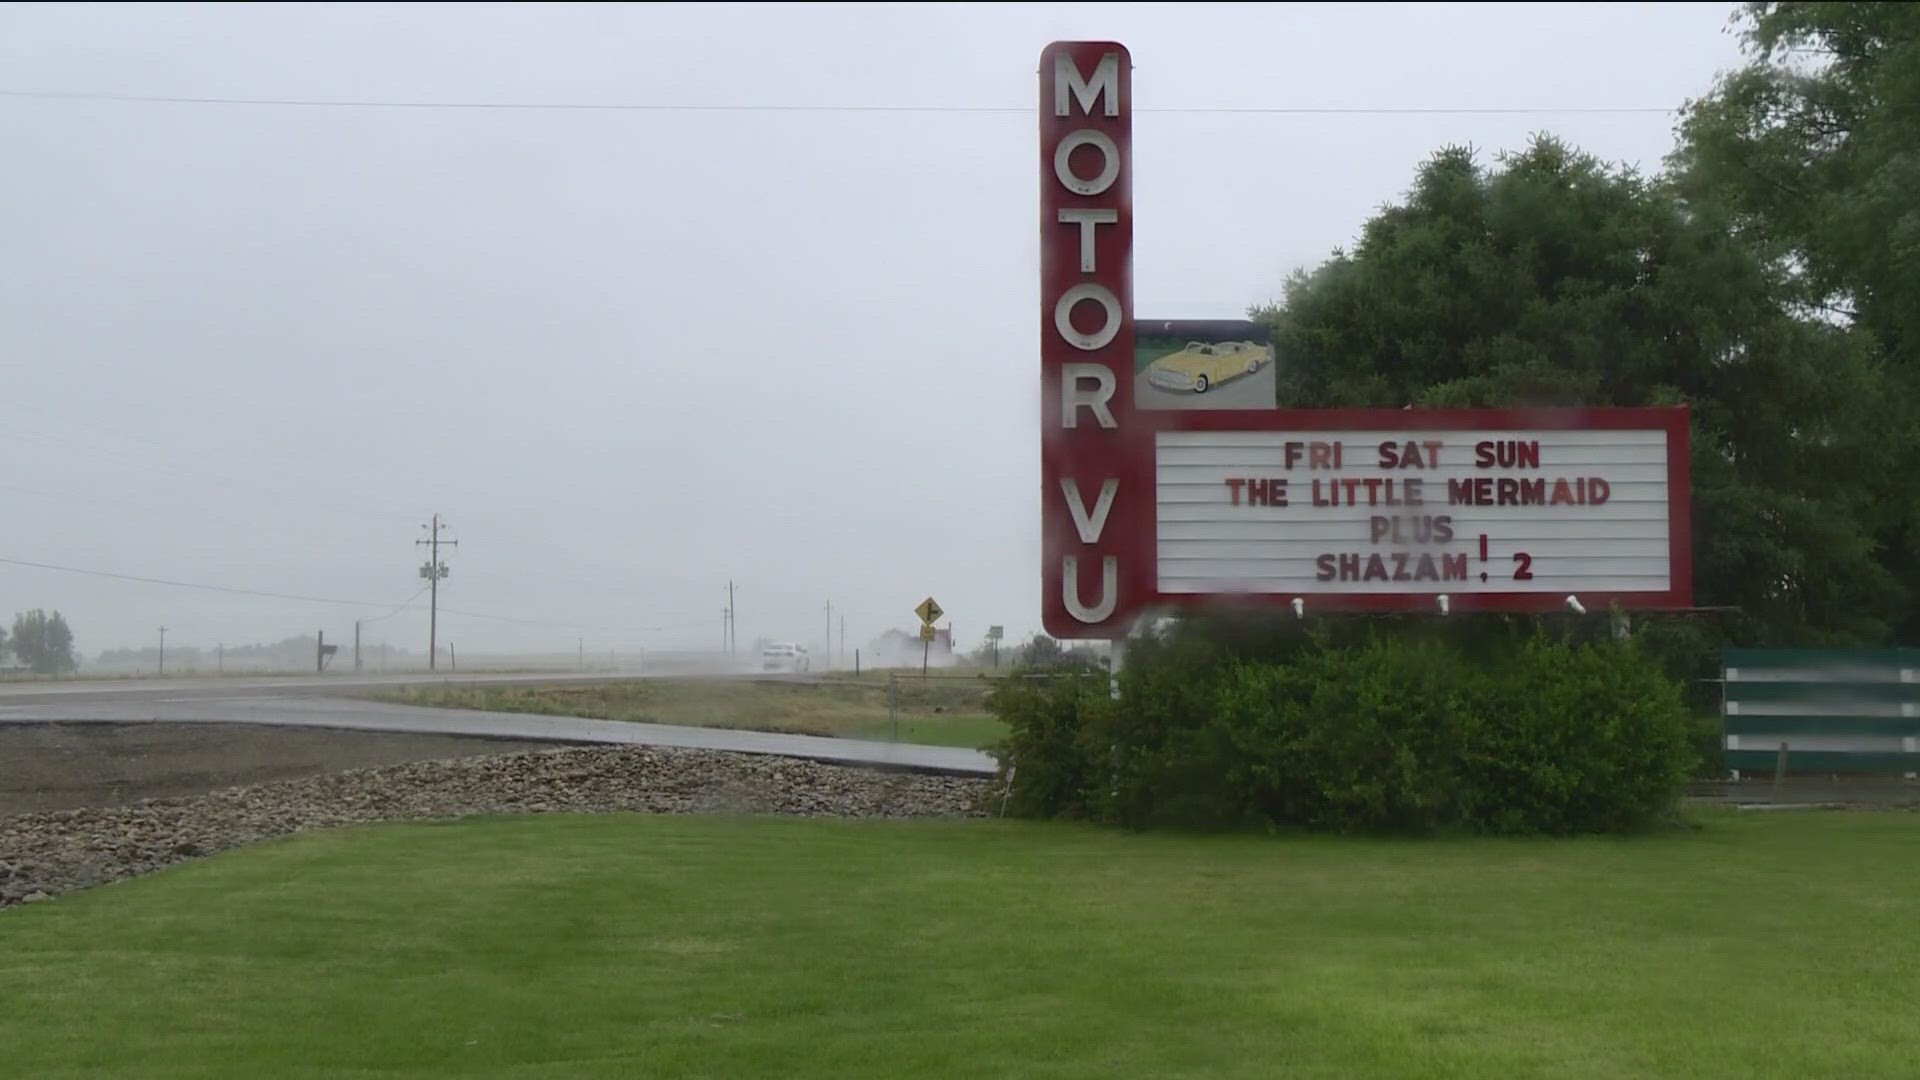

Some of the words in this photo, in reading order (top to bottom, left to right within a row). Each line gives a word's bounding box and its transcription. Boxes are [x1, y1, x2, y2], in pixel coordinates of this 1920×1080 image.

[1054, 52, 1123, 429] MOTOR
[1284, 441, 1342, 470] FRI
[1378, 441, 1444, 470] SAT
[1475, 441, 1540, 469] SUN
[1225, 478, 1288, 507] THE
[1312, 478, 1423, 507] LITTLE
[1448, 477, 1611, 506] MERMAID
[1370, 515, 1454, 545] PLUS
[1060, 478, 1121, 624] VU
[1512, 552, 1533, 581] 2
